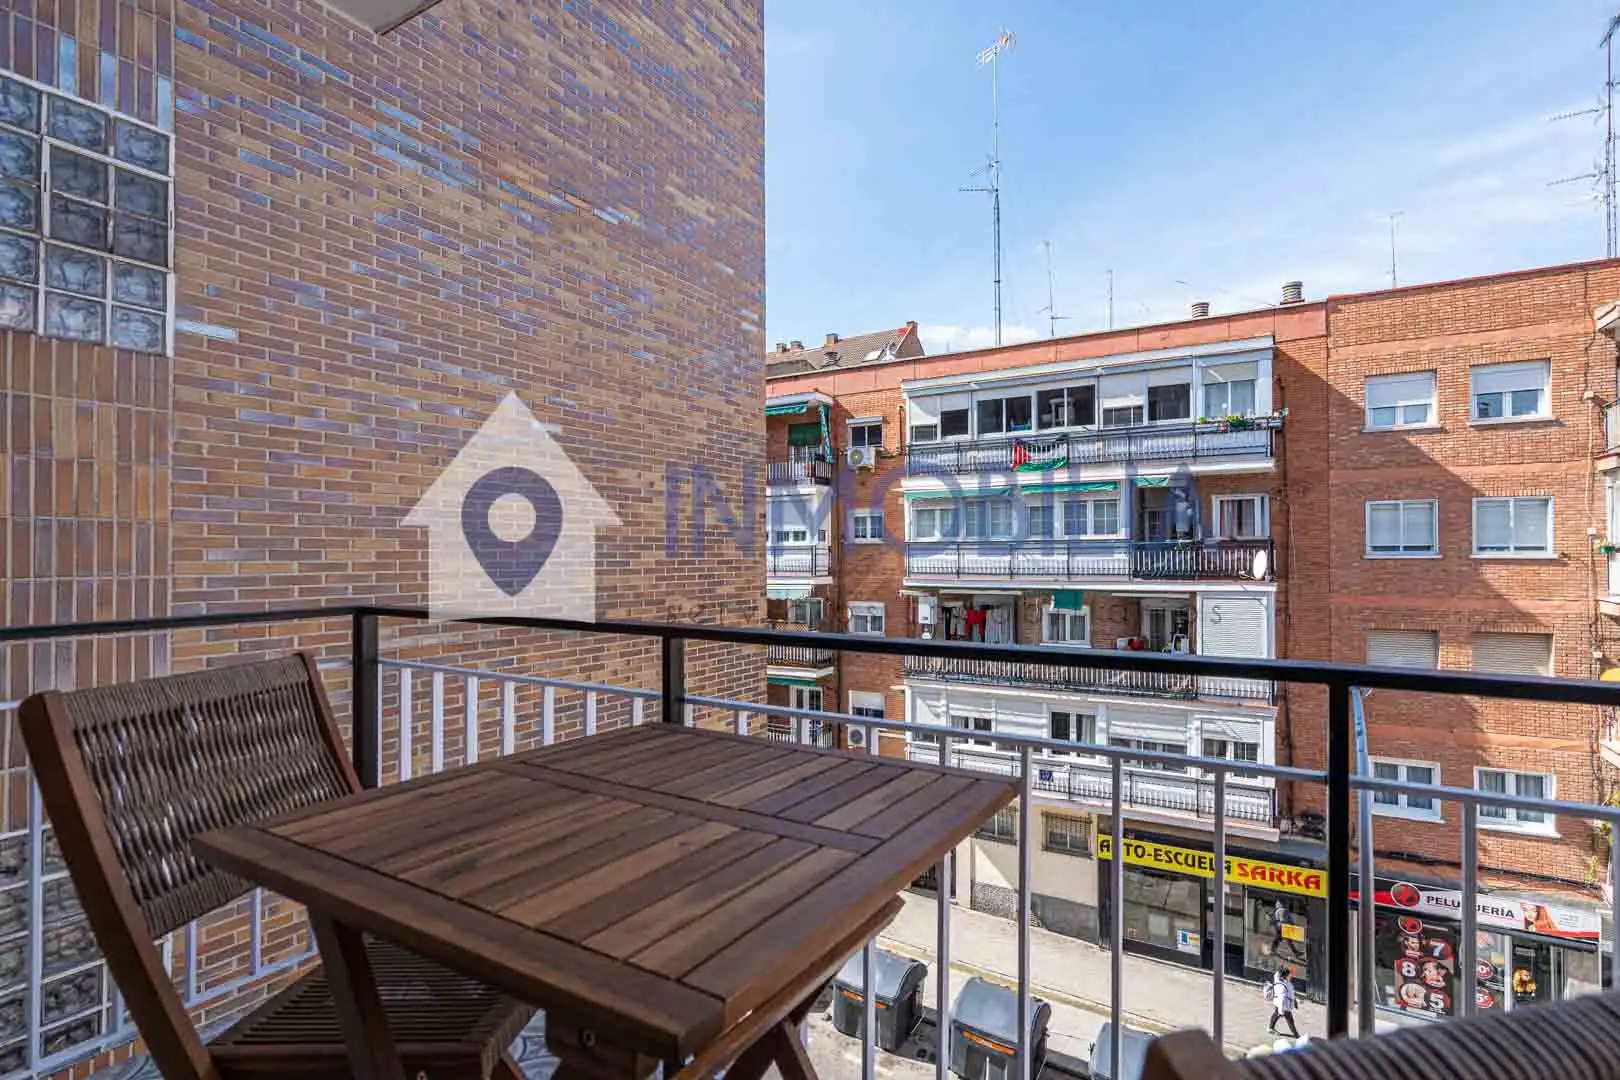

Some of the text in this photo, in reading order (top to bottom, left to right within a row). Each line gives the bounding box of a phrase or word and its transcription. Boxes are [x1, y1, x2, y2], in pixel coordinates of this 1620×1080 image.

[1099, 839, 1321, 890] ATO-ESCUELA SARKA
[1430, 941, 1446, 957] 7
[1402, 961, 1416, 977] 8
[1429, 993, 1445, 1009] 5
